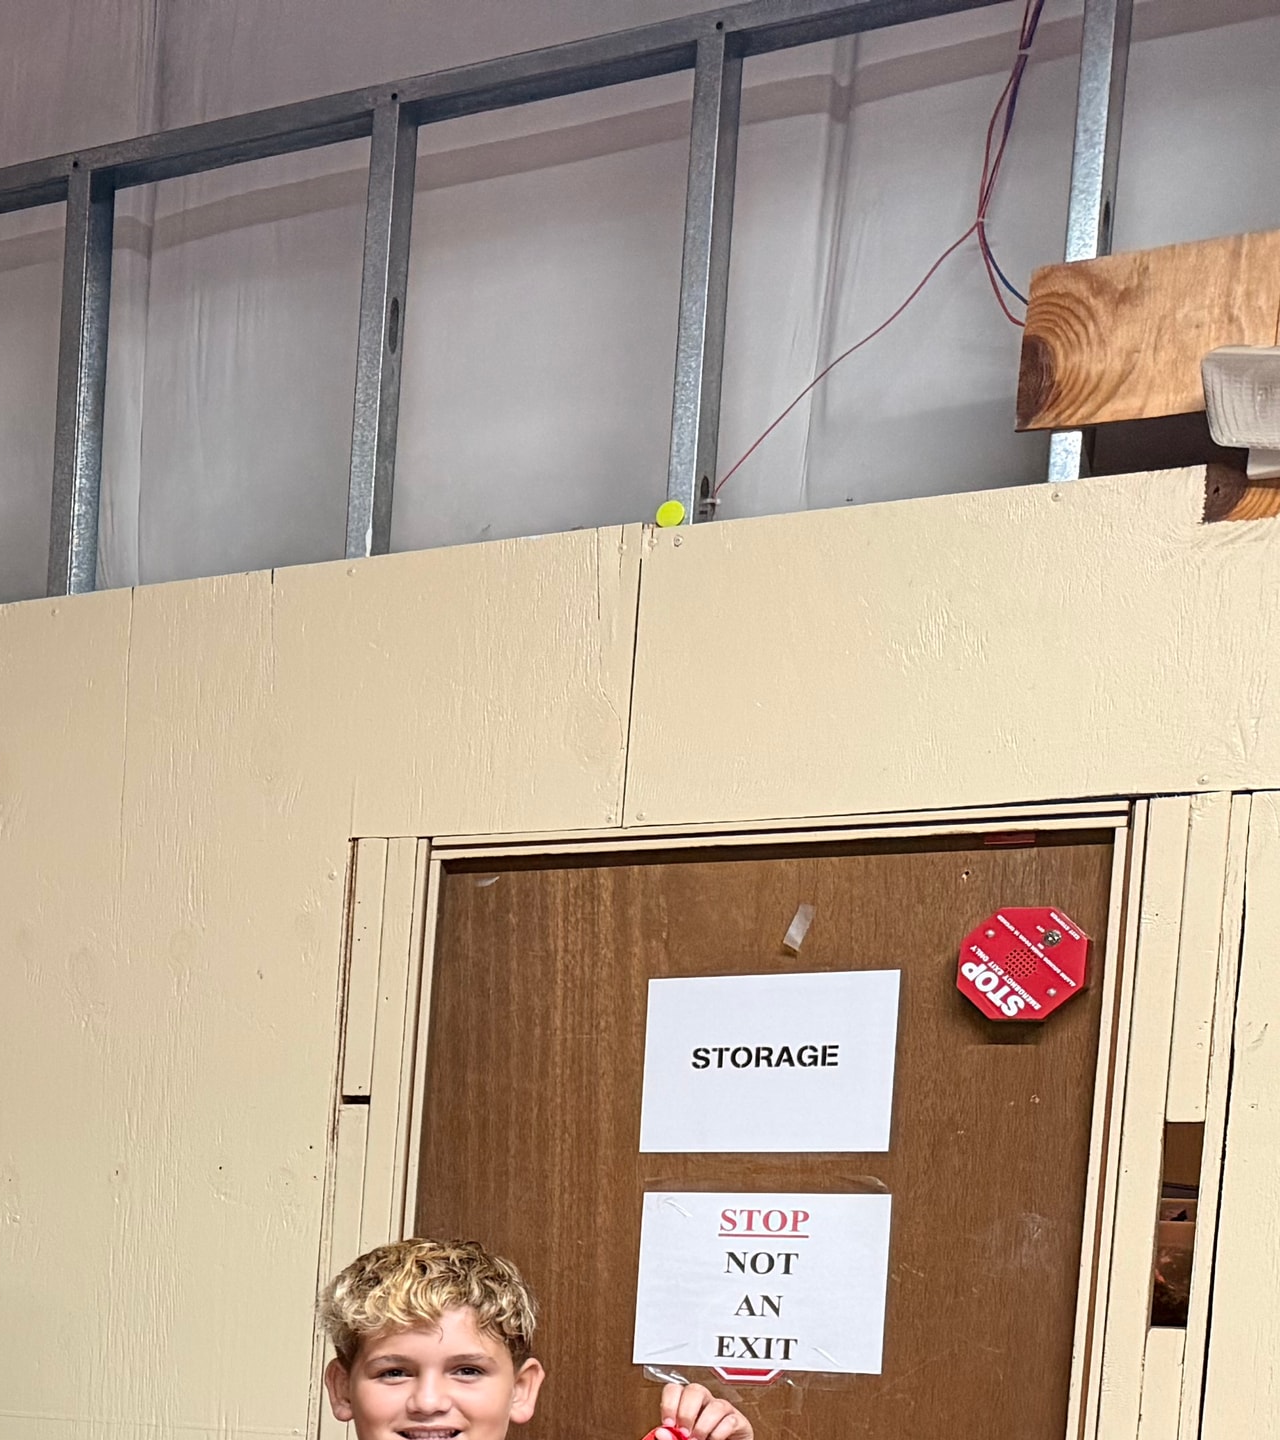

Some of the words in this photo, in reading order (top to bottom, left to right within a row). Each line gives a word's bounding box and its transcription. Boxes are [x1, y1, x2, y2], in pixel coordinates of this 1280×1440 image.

[970, 944, 989, 962] ONLY
[987, 961, 1005, 976] EXIT
[961, 962, 1025, 1017] STOP
[1002, 975, 1041, 1010] EMERGENCY
[691, 1044, 840, 1069] STORAGE
[719, 1208, 811, 1234] STOP
[724, 1251, 799, 1276] NOT
[733, 1295, 784, 1319] AN
[714, 1335, 798, 1361] EXIT
